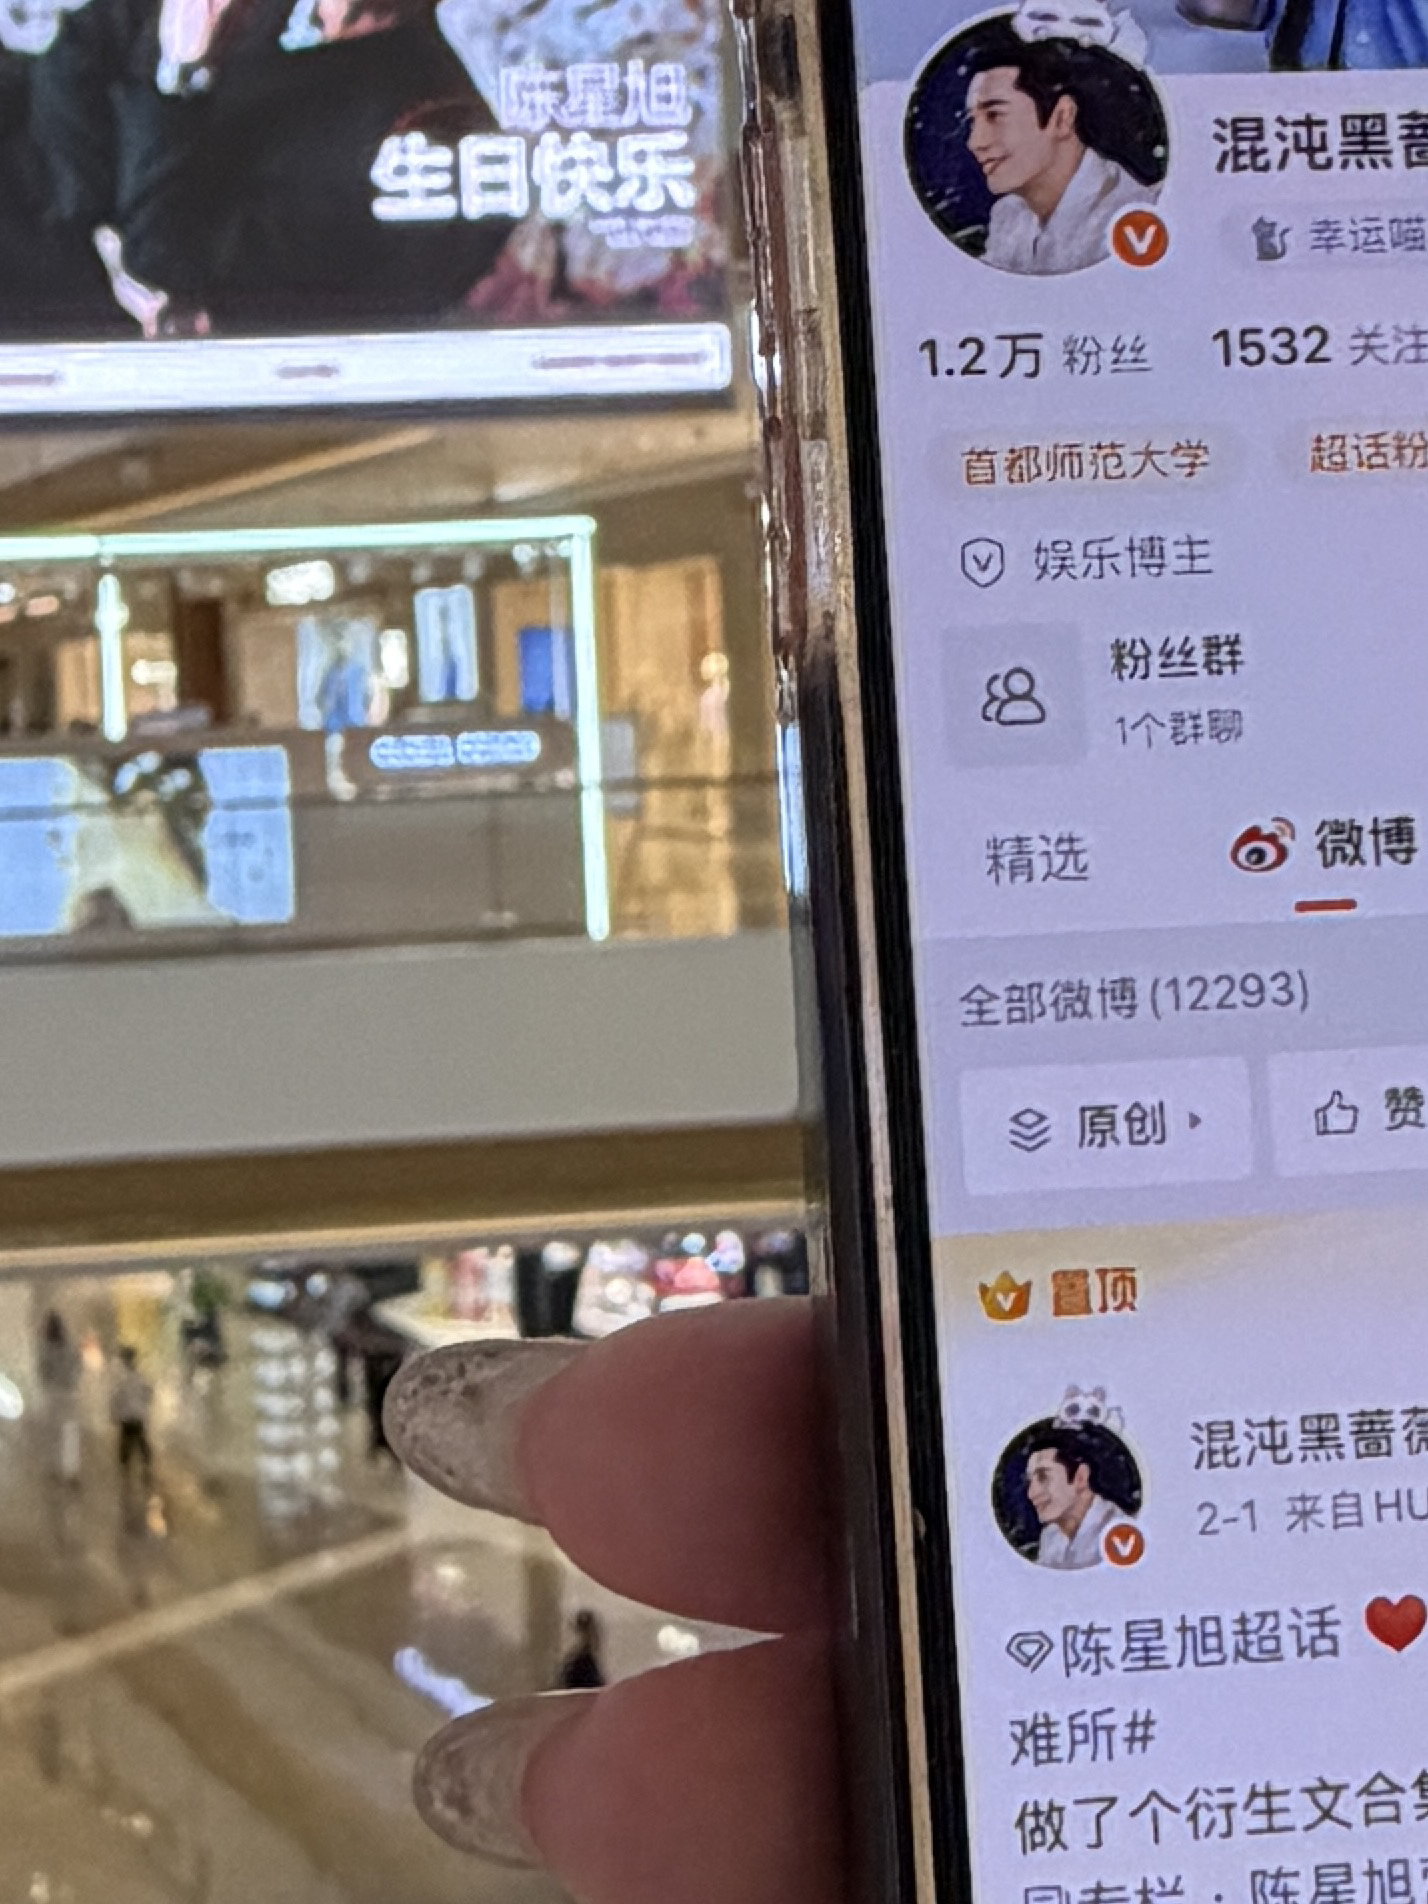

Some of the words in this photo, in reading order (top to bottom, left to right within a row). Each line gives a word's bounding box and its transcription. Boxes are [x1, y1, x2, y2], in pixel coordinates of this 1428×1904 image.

[369, 130, 696, 221] 生日快乐
[1309, 215, 1428, 256] 幸运喵
[919, 331, 1044, 380] 1.2万
[1061, 333, 1153, 376] 粉丝
[1212, 323, 1333, 368] 1532
[960, 438, 1211, 487] 首都师范大学
[1033, 533, 1214, 583] 娱乐博主
[1110, 632, 1246, 682] 粉丝群
[1115, 709, 1245, 749] 1个群聊
[986, 832, 1091, 886] 精选
[1314, 815, 1420, 870] 微博
[1078, 1099, 1168, 1150] 原创
[1383, 1086, 1427, 1132] 赞
[1050, 1266, 1139, 1319] 置顶
[1197, 1499, 1259, 1536] 2-1
[1061, 1604, 1343, 1678] 陈星旭超话
[1008, 1707, 1158, 1768] 难所#
